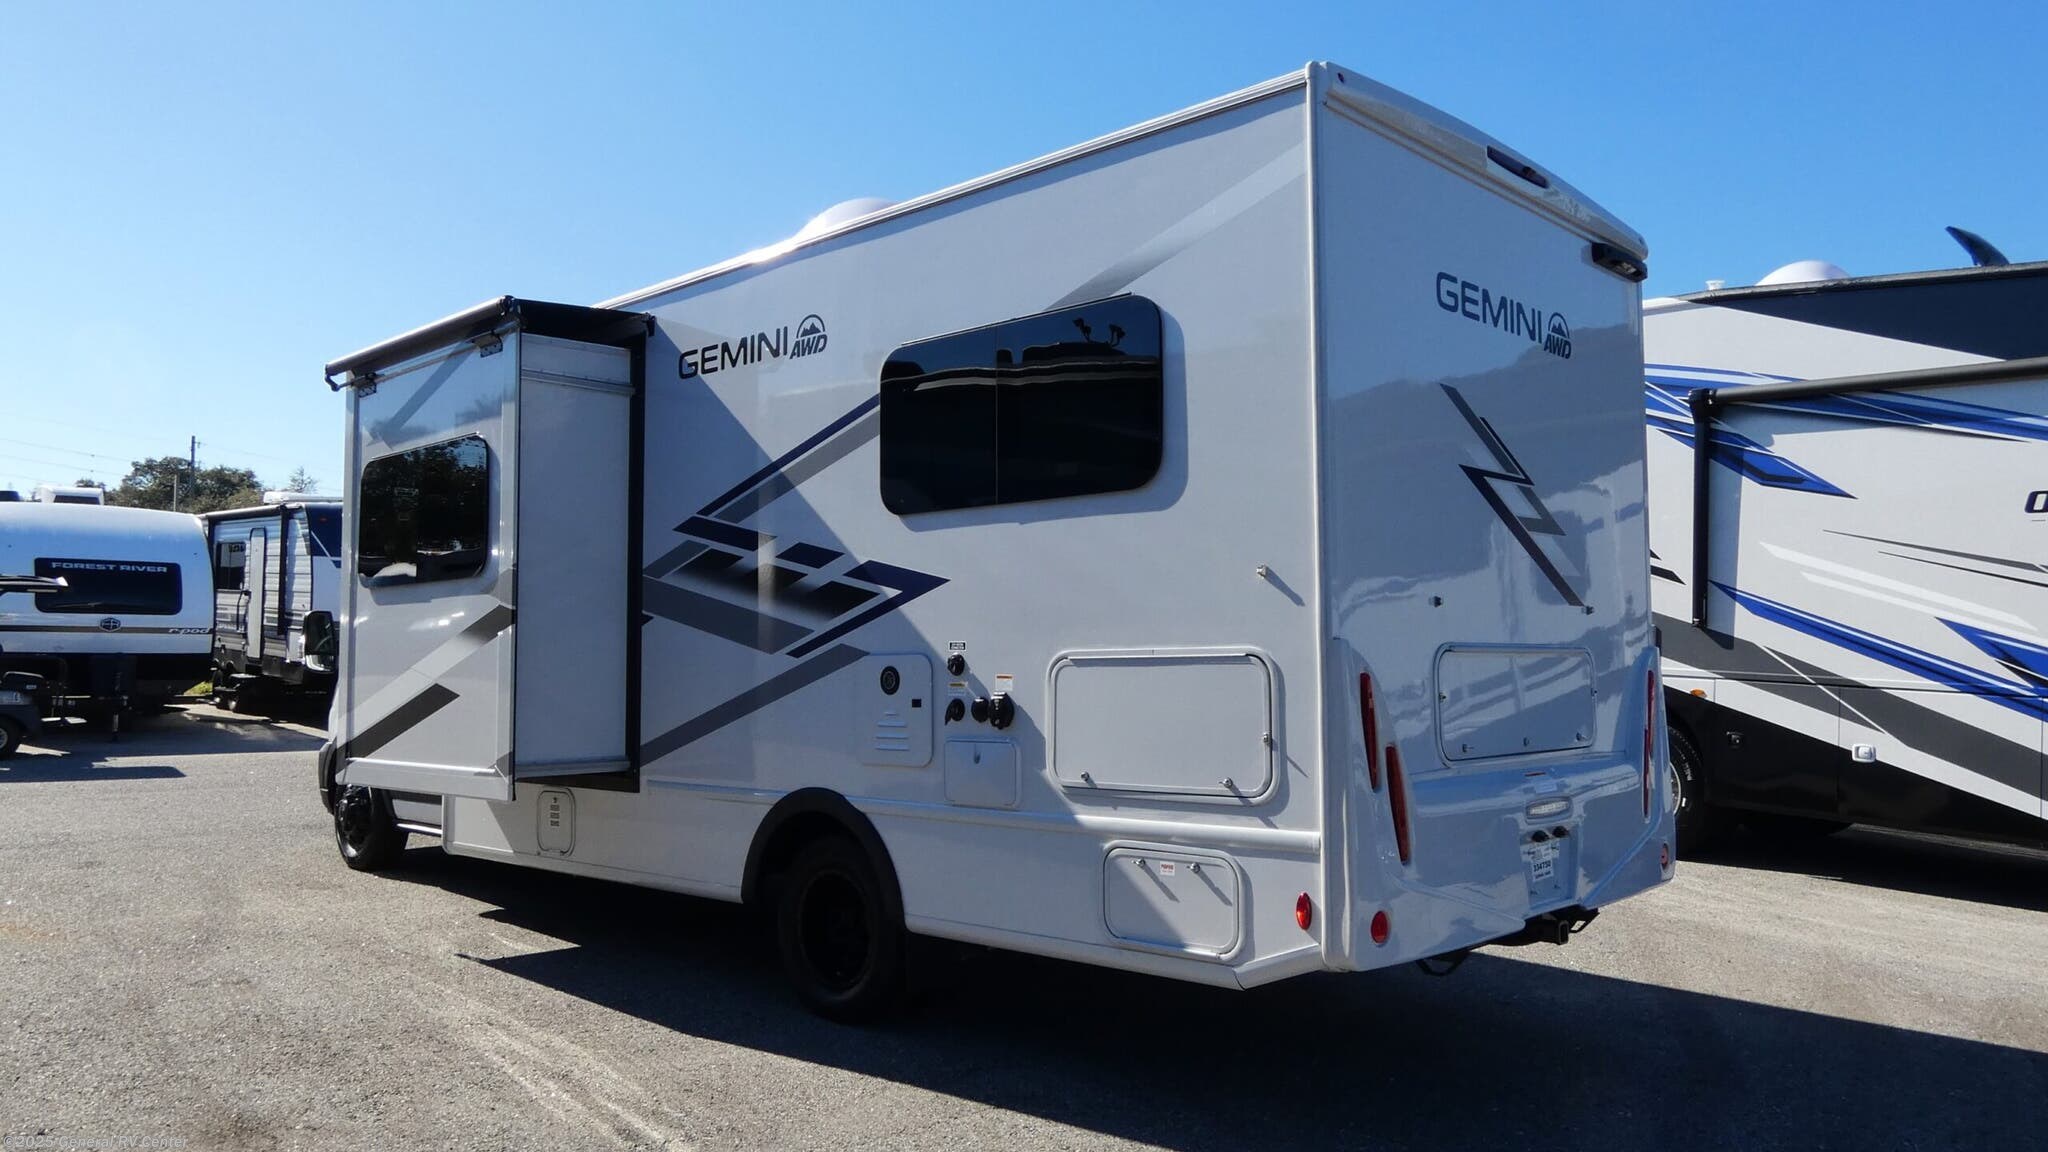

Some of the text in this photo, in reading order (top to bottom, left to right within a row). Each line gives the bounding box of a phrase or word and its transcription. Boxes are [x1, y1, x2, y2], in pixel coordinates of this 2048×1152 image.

[1436, 271, 1572, 359] GEMINI AWD
[678, 326, 828, 380] GEMINI AWD
[52, 561, 167, 573] FOREST RIVER
